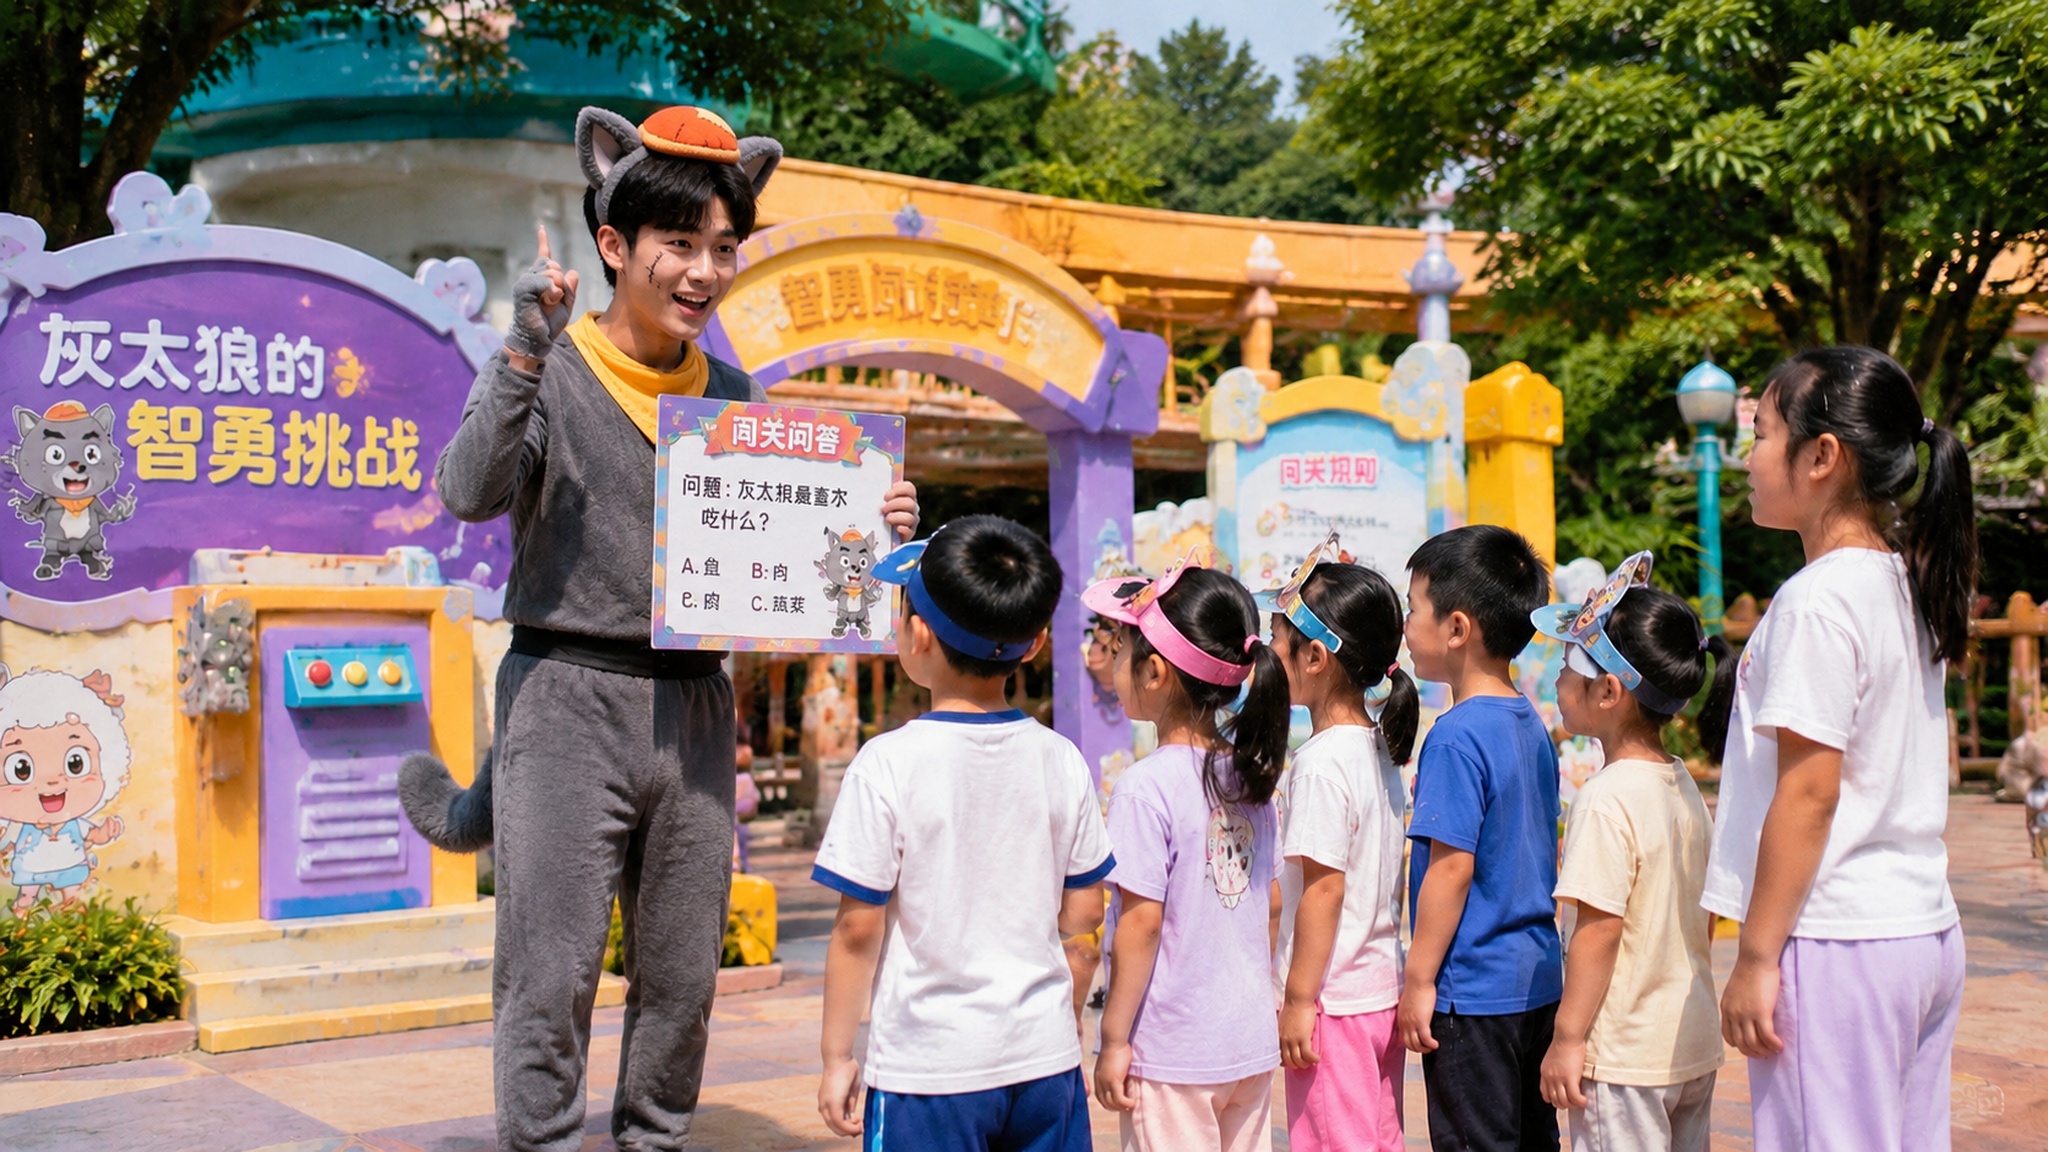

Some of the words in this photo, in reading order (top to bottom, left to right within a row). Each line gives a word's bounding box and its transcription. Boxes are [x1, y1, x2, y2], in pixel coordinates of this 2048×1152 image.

[39, 312, 325, 399] 灰太狼的
[126, 399, 423, 491] 智勇挑战
